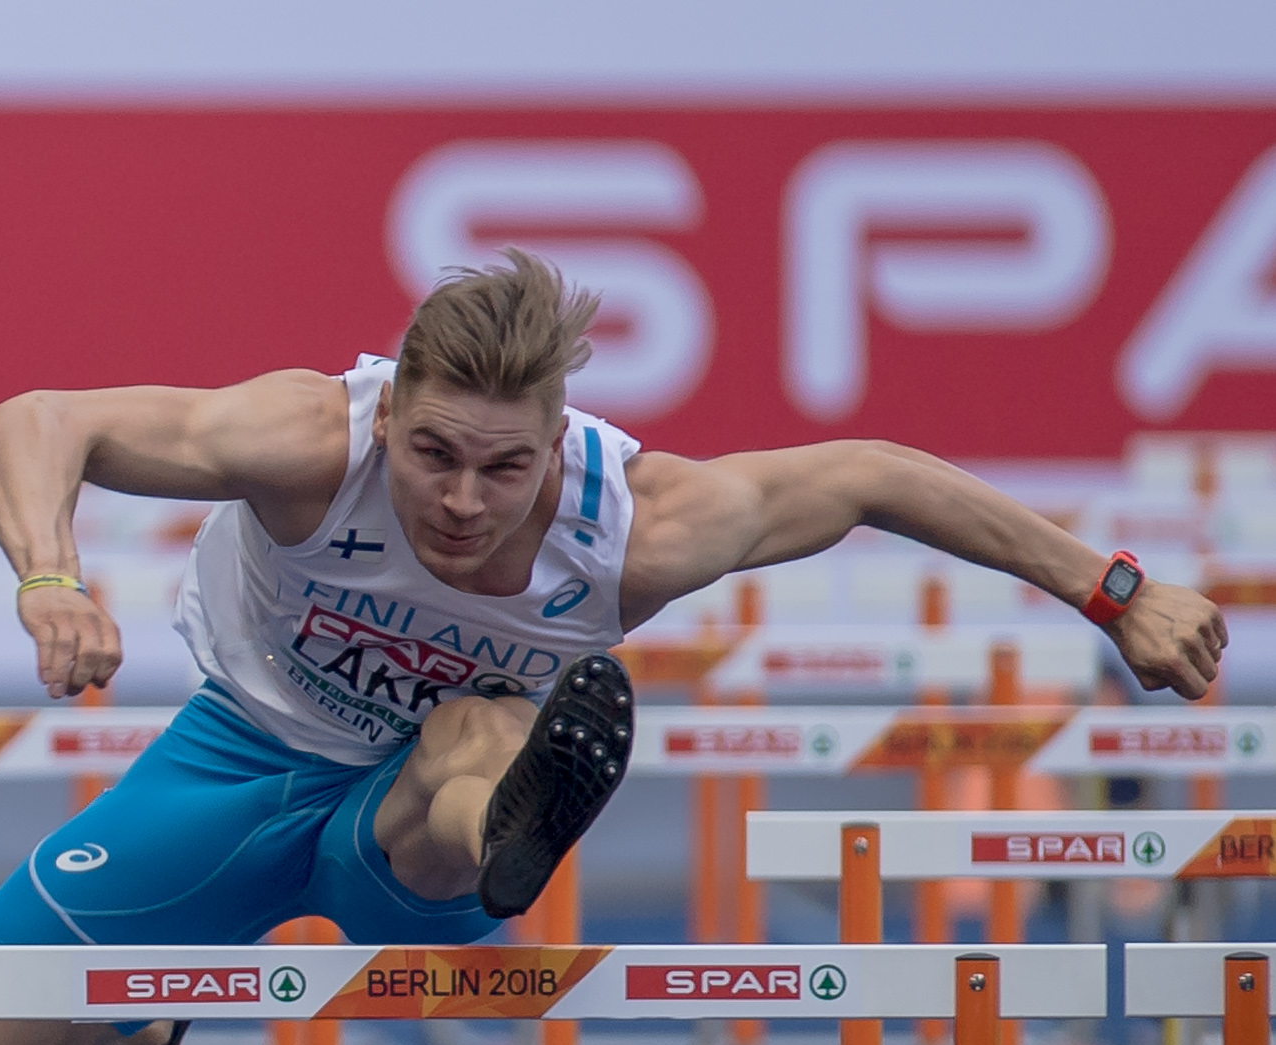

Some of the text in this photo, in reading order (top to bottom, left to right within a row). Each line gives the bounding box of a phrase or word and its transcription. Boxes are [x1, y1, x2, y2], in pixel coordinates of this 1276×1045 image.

[291, 634, 459, 713] LAKK
[288, 665, 384, 743] BERLIN
[372, 705, 416, 733] CLEA
[1006, 837, 1123, 861] SPAR
[1220, 834, 1275, 861] BER
[126, 972, 258, 998] SPAR
[367, 969, 557, 997] BERLIN 2018
[666, 970, 798, 995] SPAR
